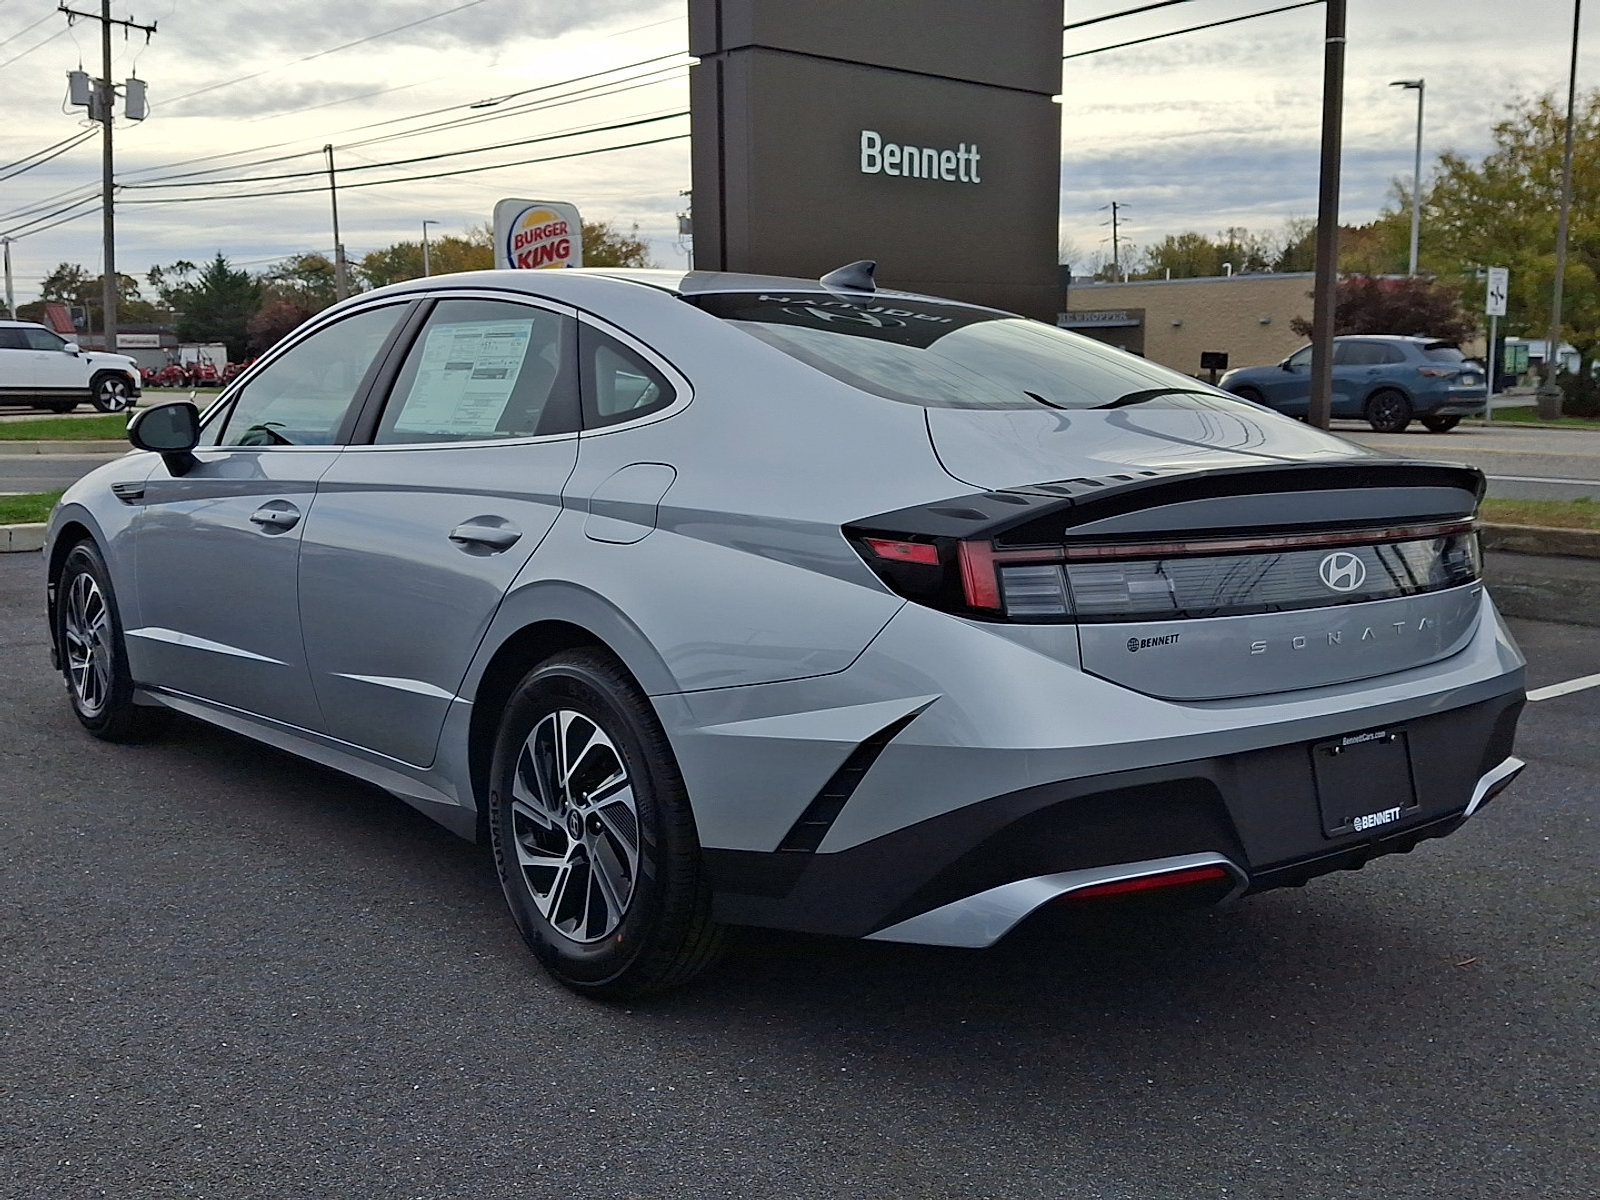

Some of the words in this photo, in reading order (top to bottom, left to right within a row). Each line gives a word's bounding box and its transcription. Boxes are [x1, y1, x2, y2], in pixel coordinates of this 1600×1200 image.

[861, 130, 981, 183] Bennett
[514, 221, 568, 250] BURGER
[517, 238, 571, 269] KING
[1140, 633, 1180, 649] BENNETT
[1250, 617, 1431, 655] SONATA
[1342, 731, 1386, 746] BennettCars.com
[1361, 806, 1401, 829] BENNETT
